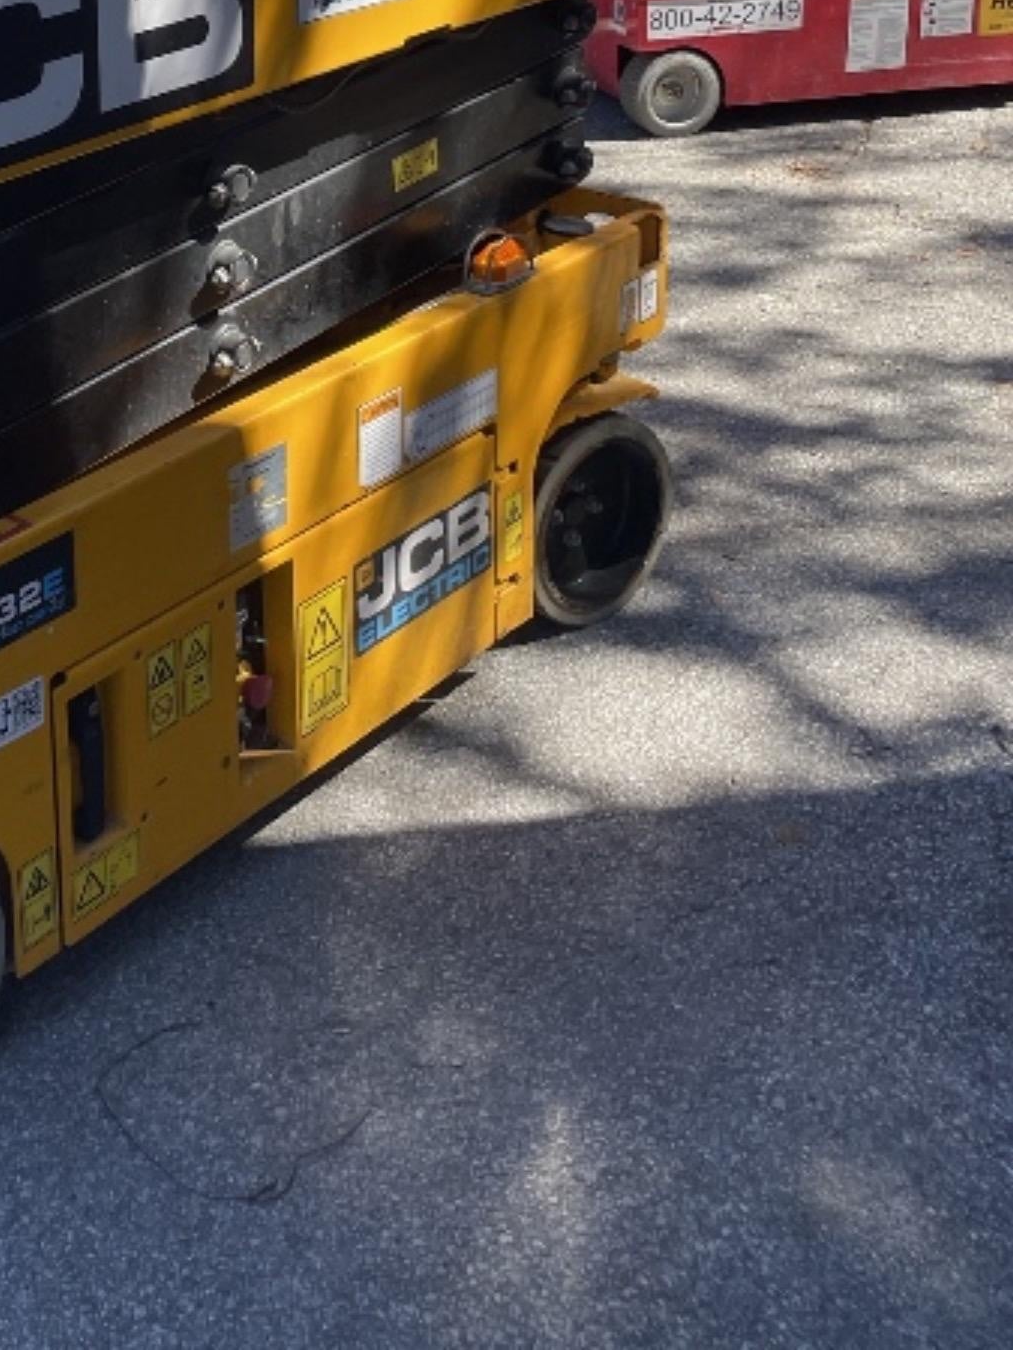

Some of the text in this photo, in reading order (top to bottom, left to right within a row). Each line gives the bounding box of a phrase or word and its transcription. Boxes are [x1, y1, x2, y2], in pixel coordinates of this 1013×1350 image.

[649, 0, 801, 31] 800-42-2749
[357, 489, 490, 620] JCB
[357, 543, 490, 652] ELECTRIC
